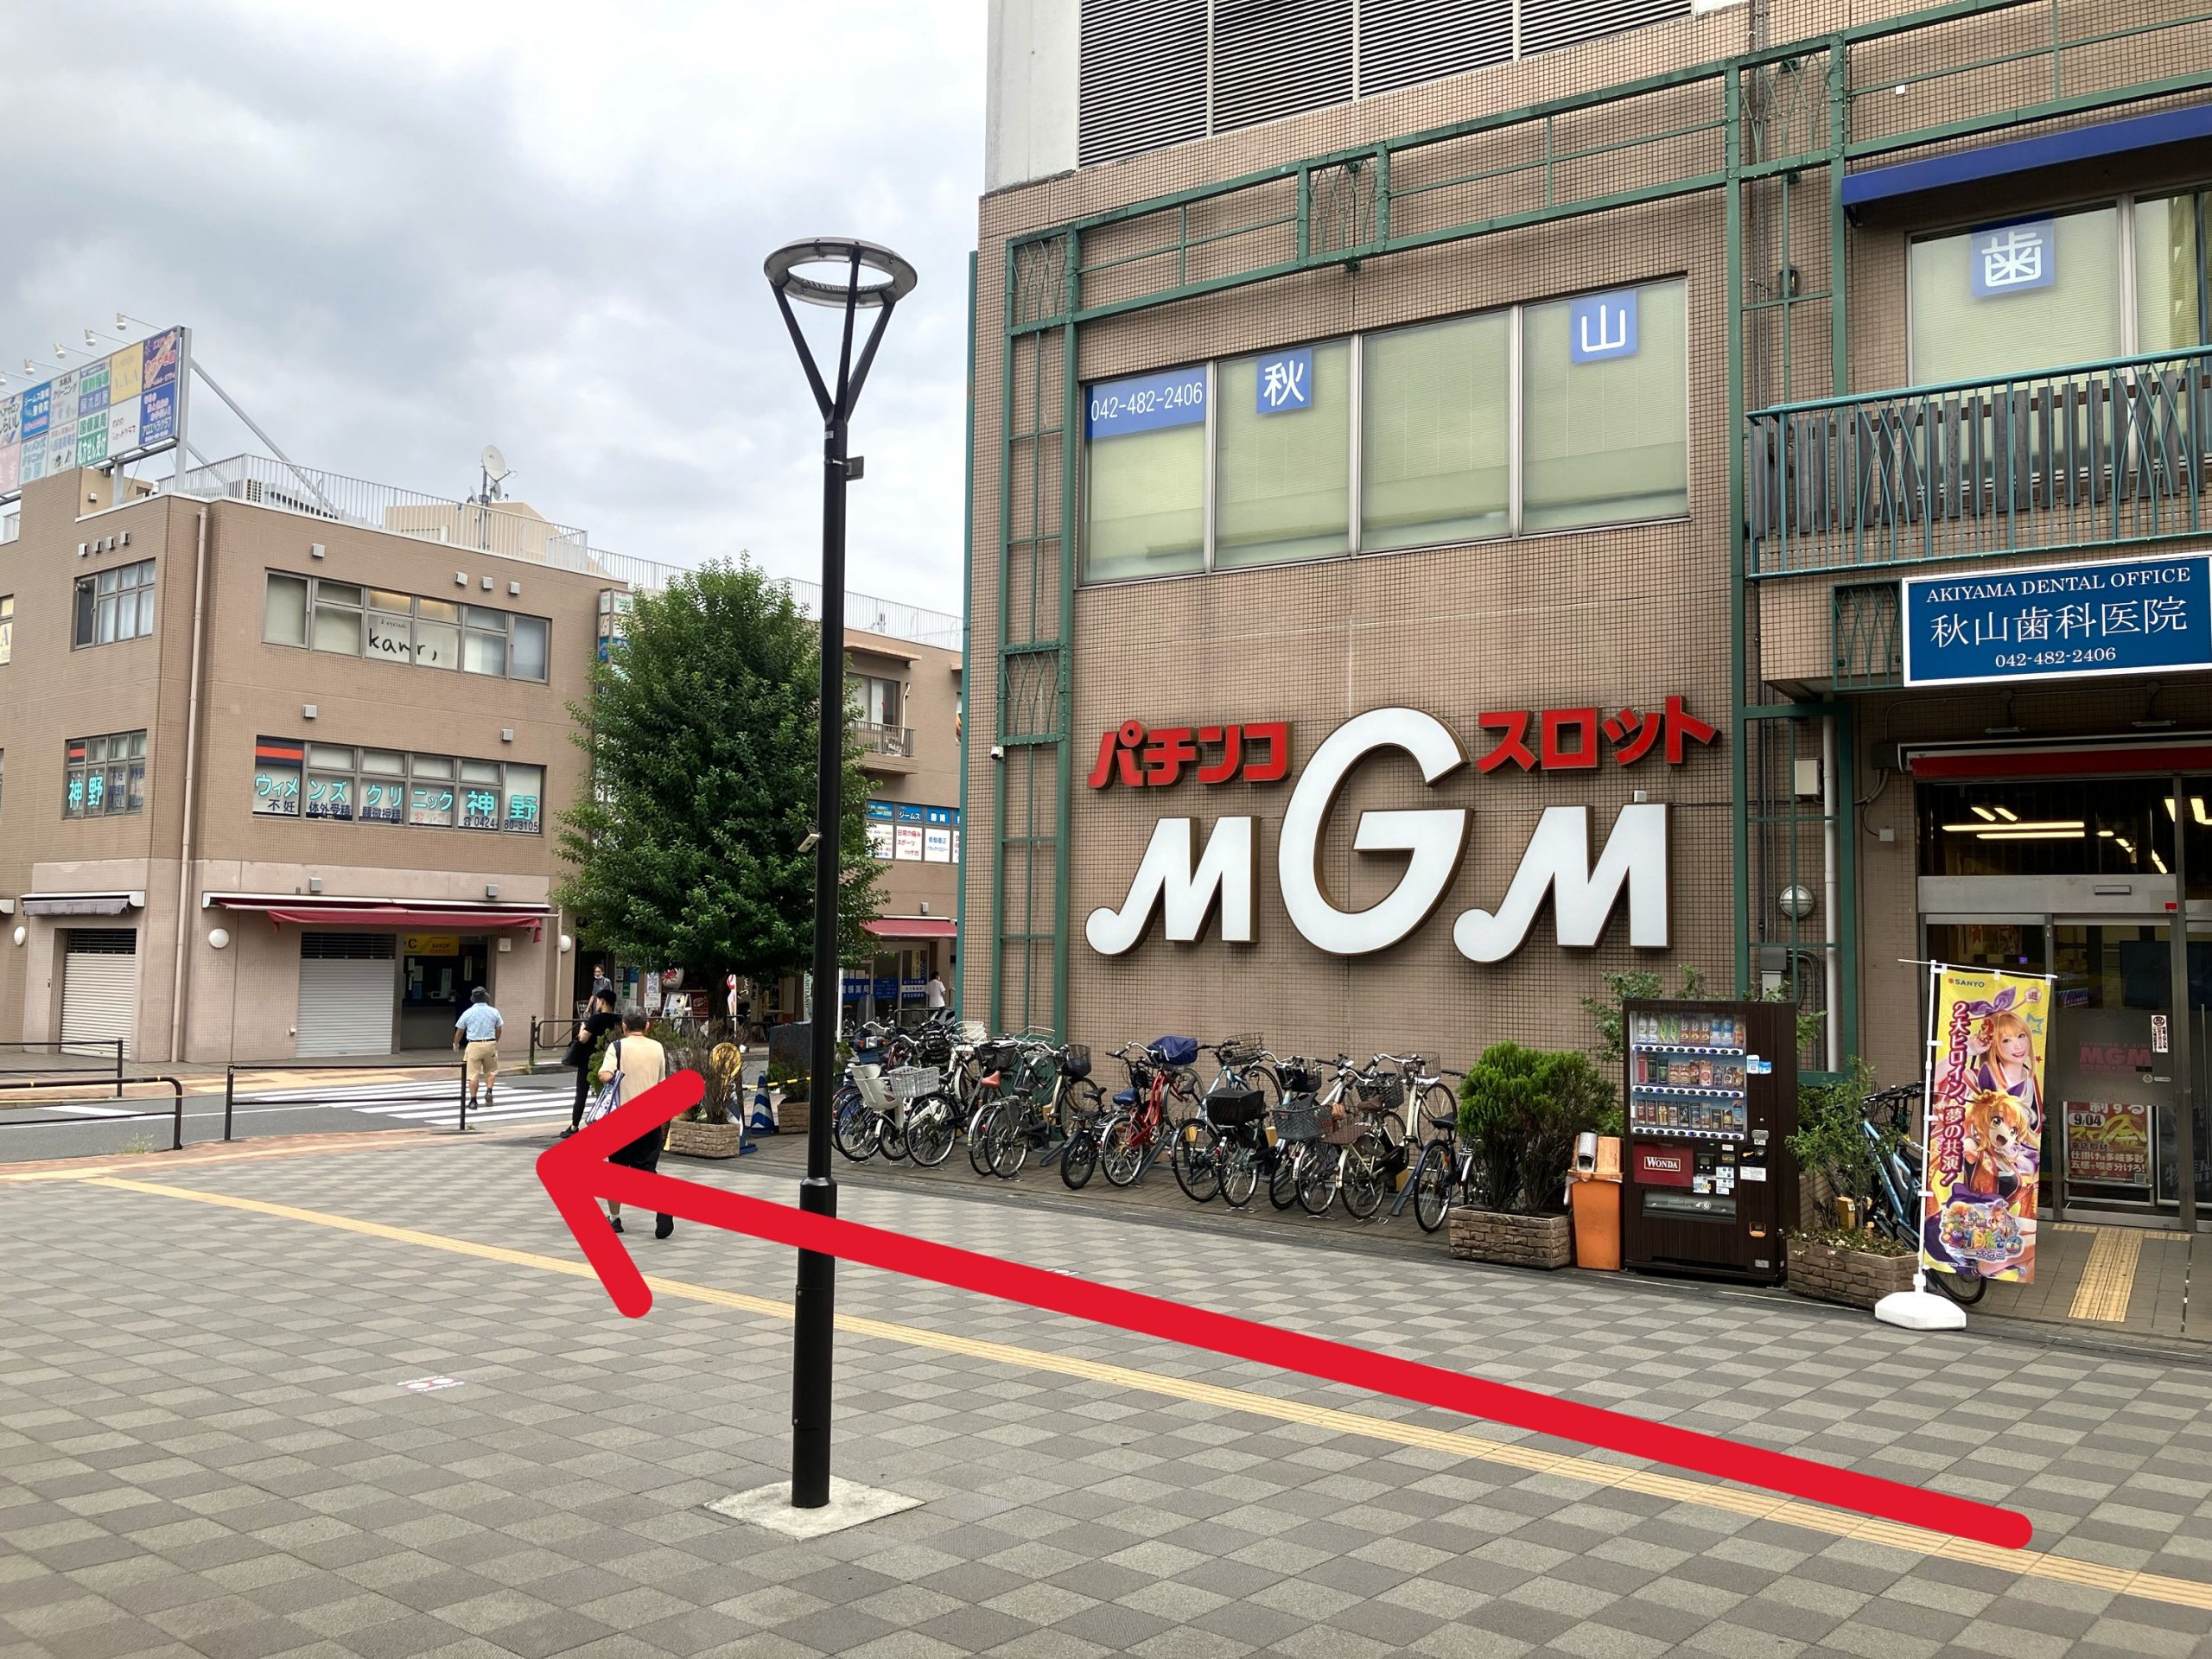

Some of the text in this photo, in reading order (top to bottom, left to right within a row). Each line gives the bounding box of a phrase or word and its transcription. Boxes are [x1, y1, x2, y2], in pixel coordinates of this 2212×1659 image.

[1981, 231, 2043, 288] 歯
[1580, 304, 1626, 353] 山
[1090, 381, 1203, 422] 042-482-2406
[1263, 359, 1305, 407] 秋
[1926, 567, 2190, 603] AKIYAMA DENTAL OFFICE
[1930, 596, 2188, 648] 秋山歯科医院
[1995, 647, 2117, 668] 042-482-2406
[1090, 695, 1719, 788] パチンコ スロット
[68, 777, 104, 809] 神野
[268, 798, 296, 813] 不妊
[308, 801, 353, 816] 体外受精
[1085, 707, 1672, 963] MGM
[1955, 978, 1985, 988] SANYO
[2080, 1046, 2152, 1065] MGM
[1646, 1157, 1678, 1169] WONDA
